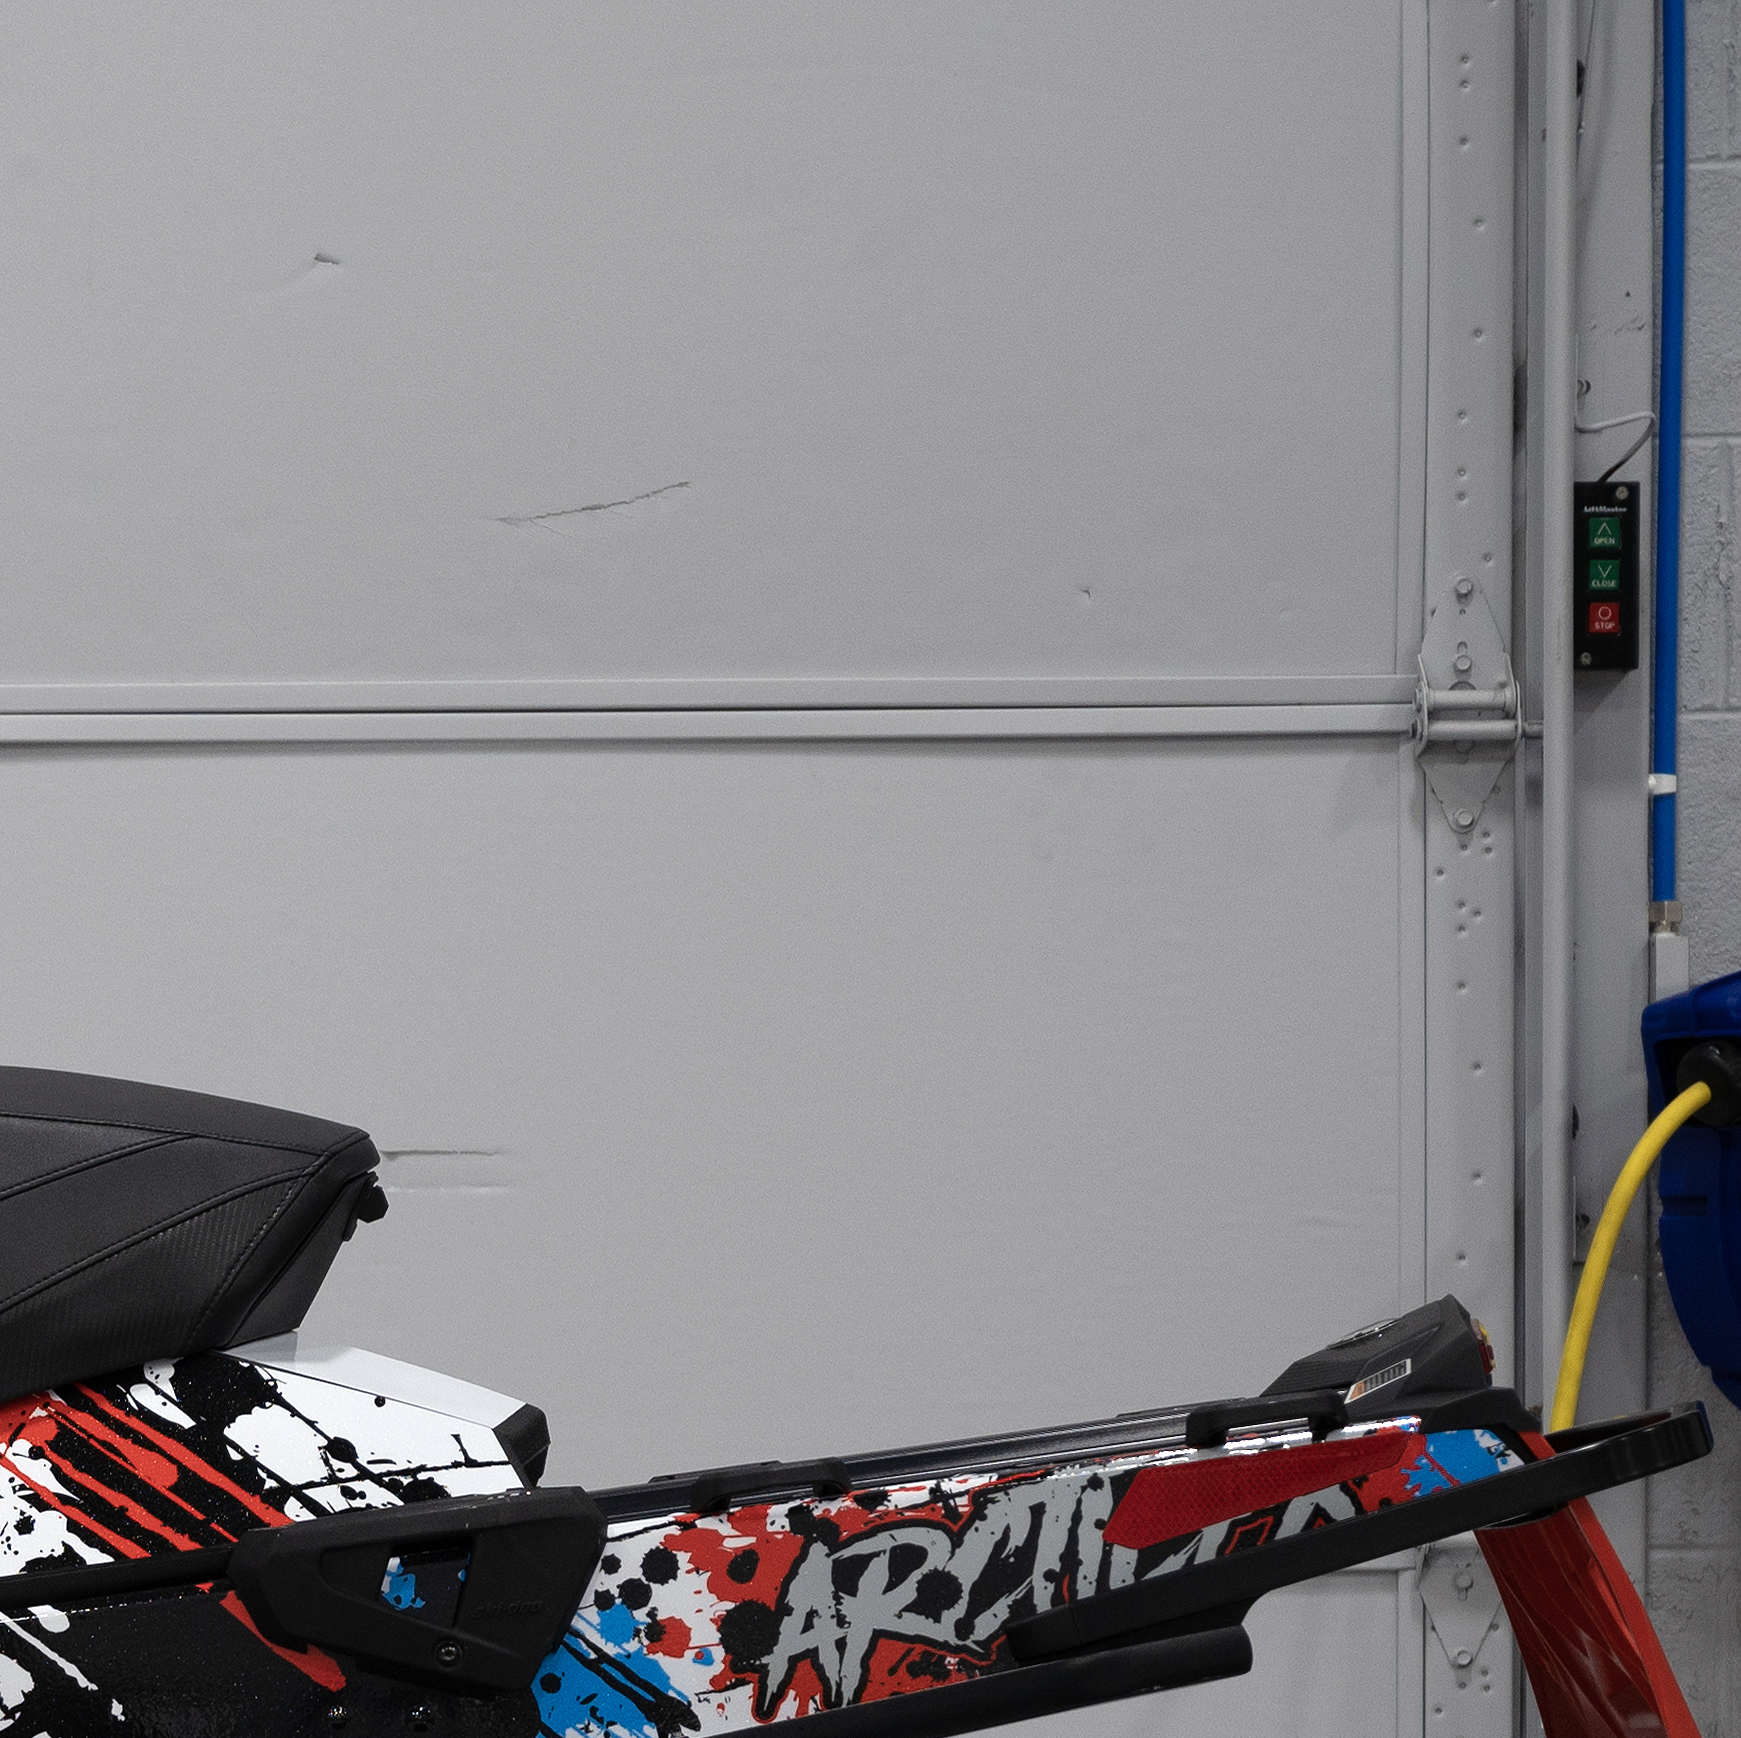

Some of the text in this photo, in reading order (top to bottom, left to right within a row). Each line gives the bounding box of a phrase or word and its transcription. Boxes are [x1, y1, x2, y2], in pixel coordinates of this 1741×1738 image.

[1594, 537, 1615, 545] OPEN
[1592, 579, 1617, 587] CLOSE
[1594, 622, 1615, 630] STOP
